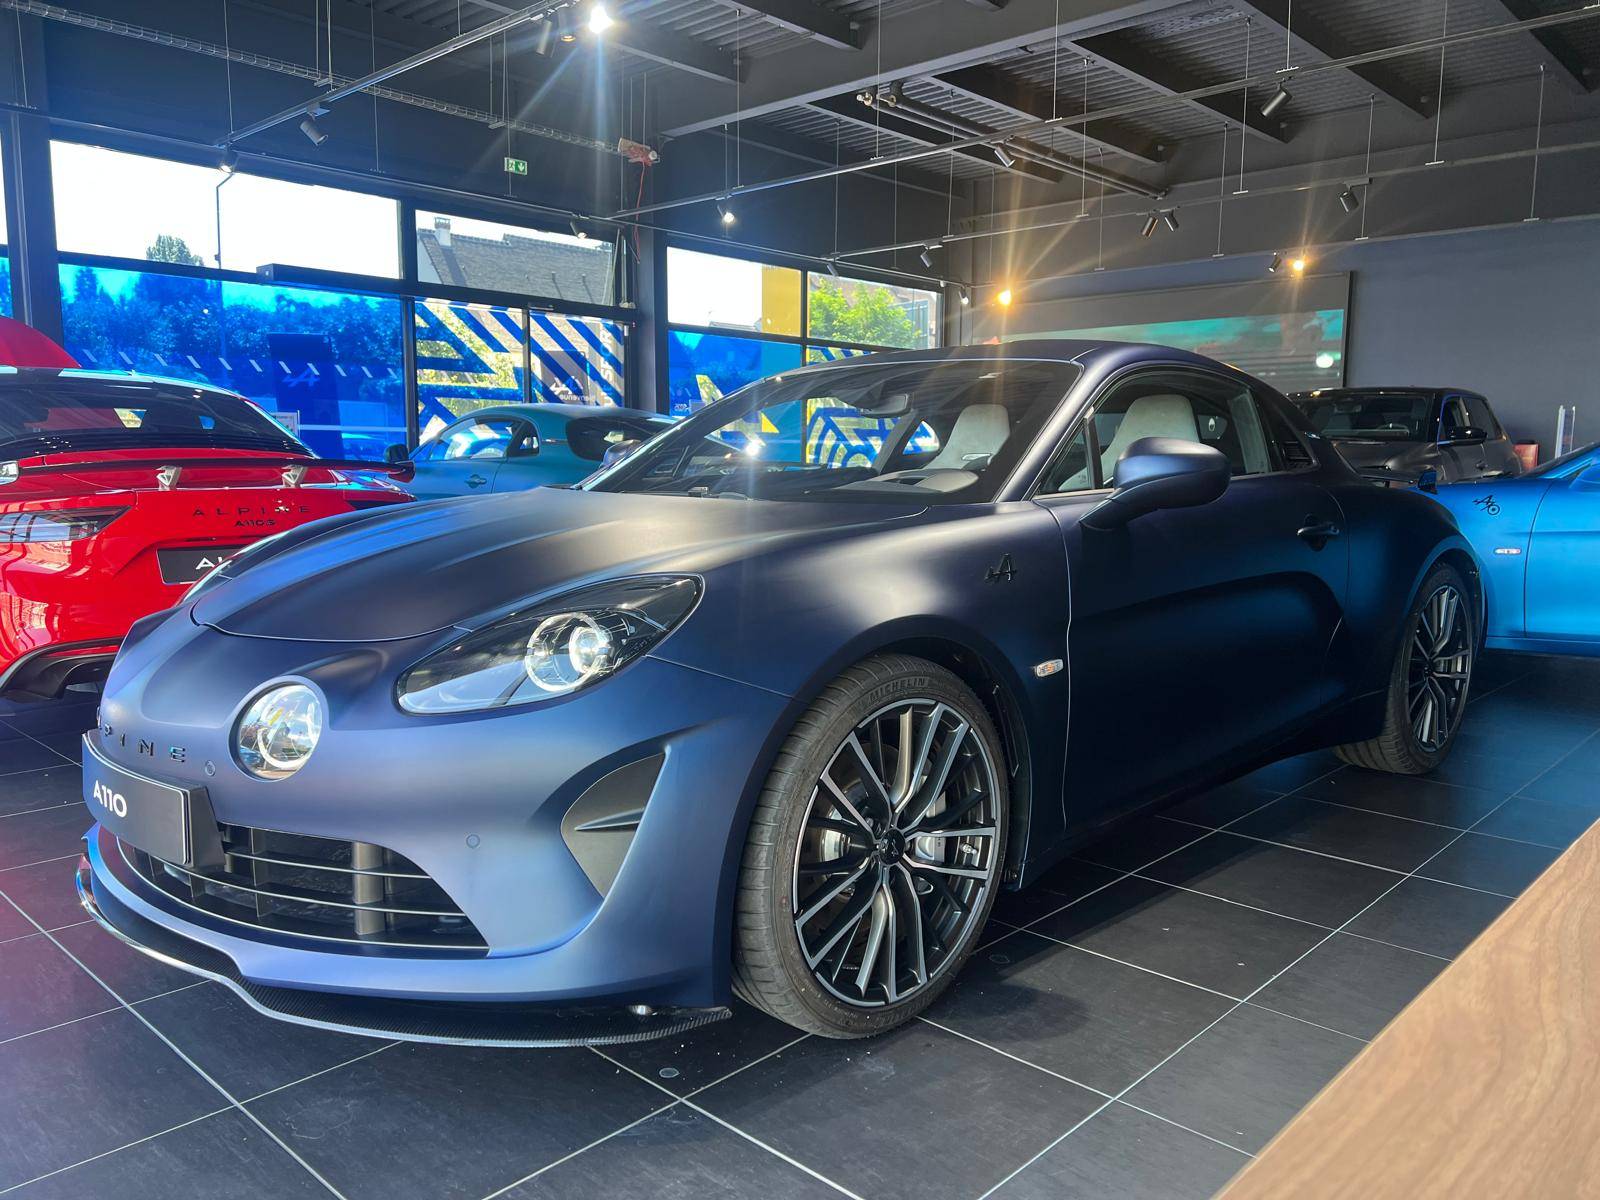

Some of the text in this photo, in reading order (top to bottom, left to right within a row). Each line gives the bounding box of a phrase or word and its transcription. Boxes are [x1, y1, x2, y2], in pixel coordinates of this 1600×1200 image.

[235, 519, 276, 528] A110S
[867, 678, 927, 704] MICHELIN
[93, 779, 128, 818] A110
